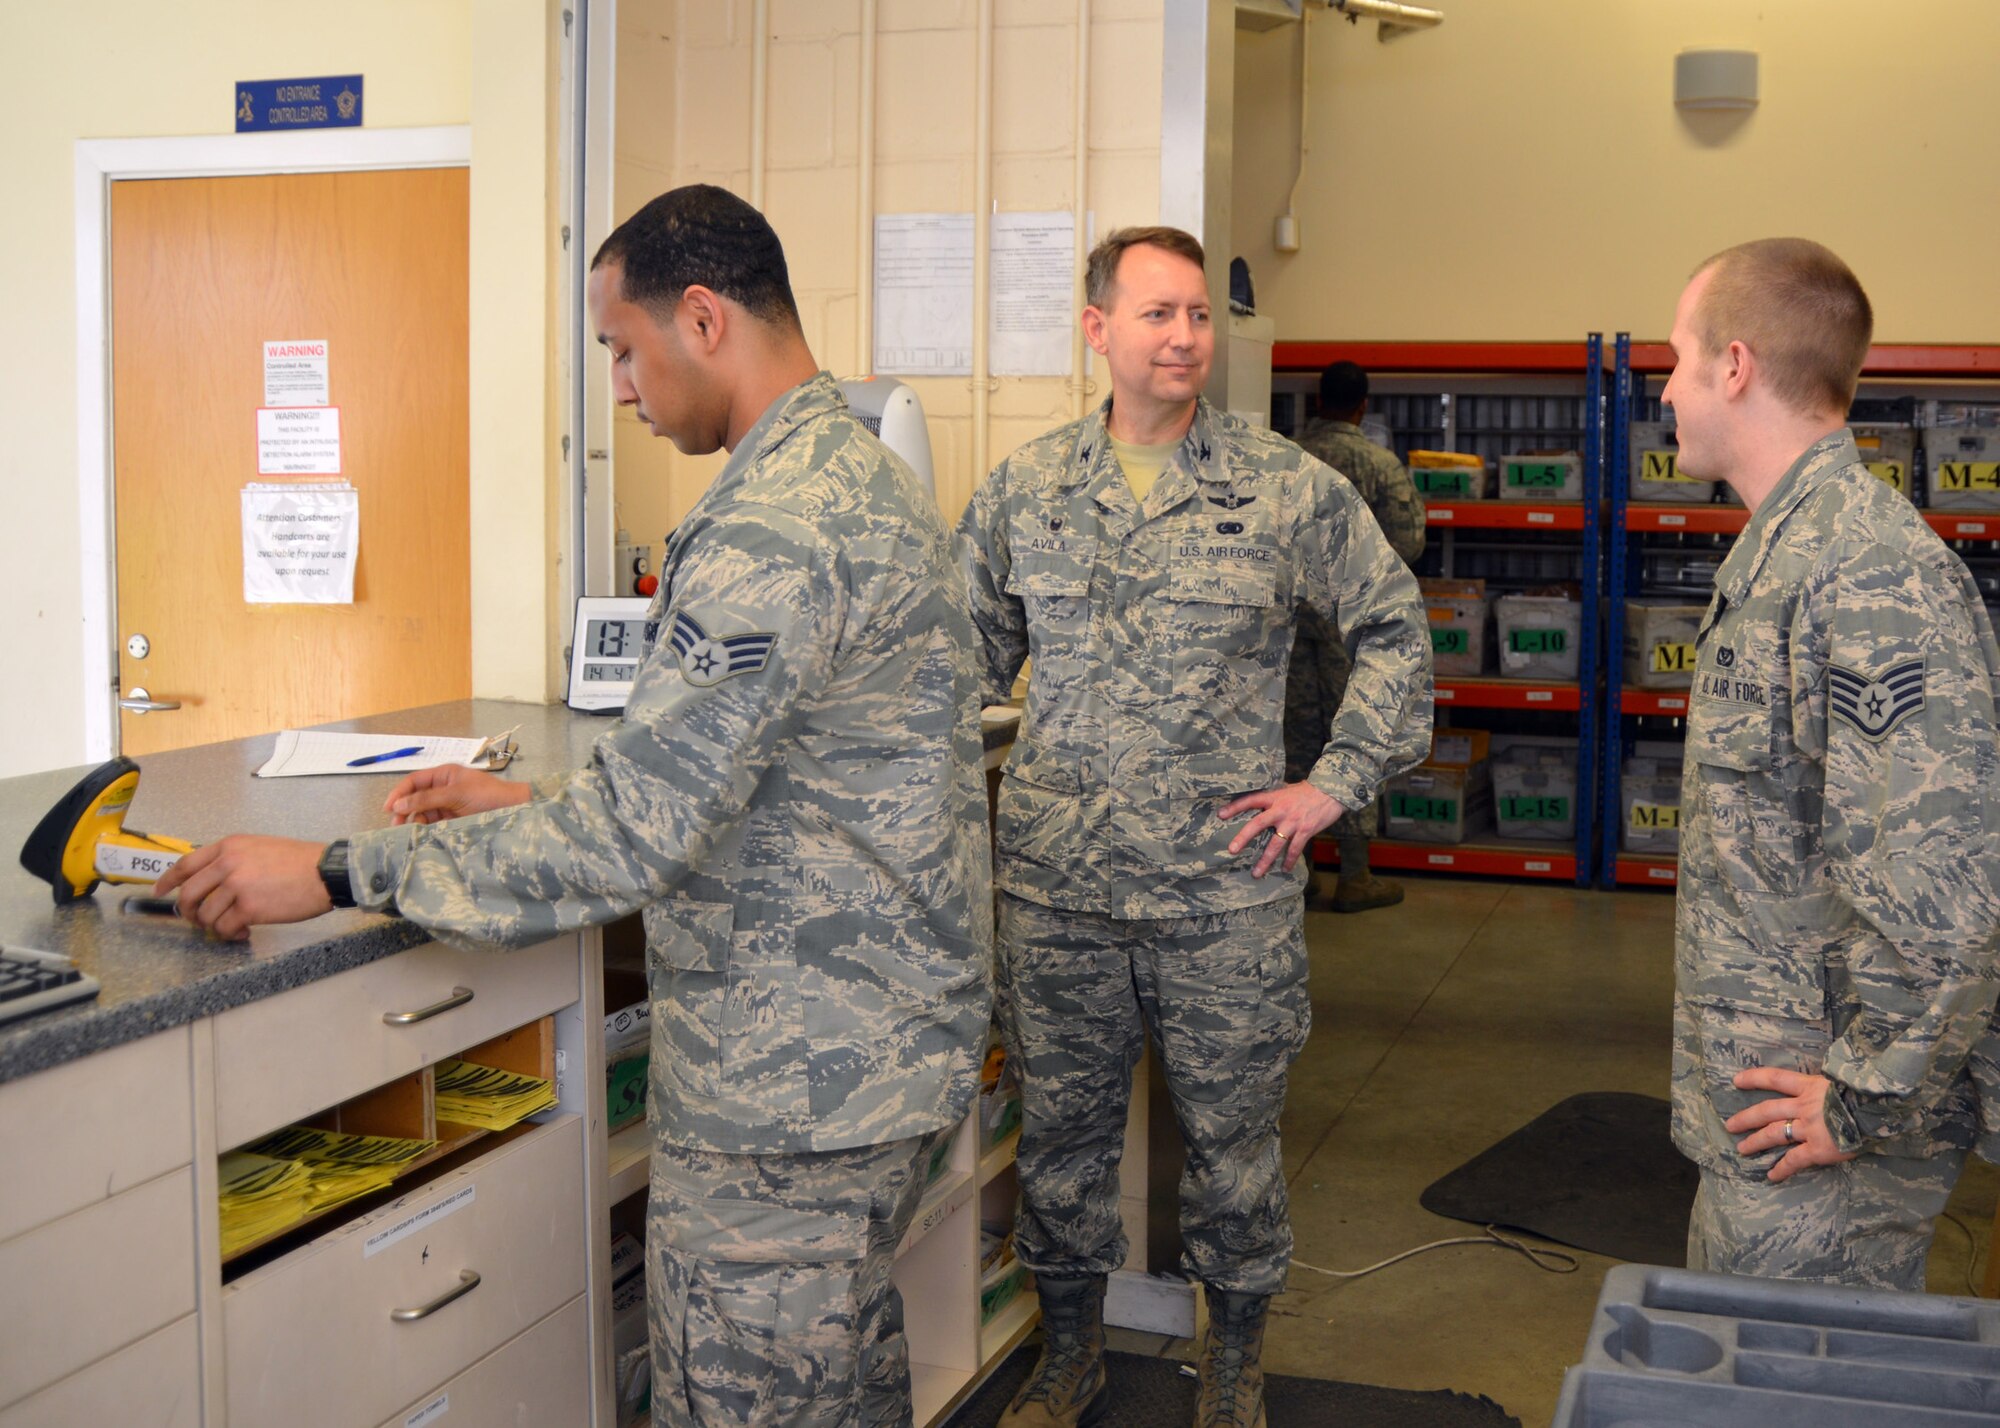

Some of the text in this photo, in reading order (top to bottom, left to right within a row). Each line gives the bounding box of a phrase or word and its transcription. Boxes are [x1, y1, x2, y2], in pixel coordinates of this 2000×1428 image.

[276, 84, 320, 102] NO ENTRANCE
[269, 105, 328, 124] CONTROLLED AREA
[267, 344, 325, 358] WARNING
[266, 361, 312, 370] Controlled Area
[1422, 473, 1461, 492] L-4
[1516, 465, 1557, 486] L-5
[257, 512, 295, 522] Attention
[272, 531, 314, 541] Handcarts
[1031, 538, 1066, 551] AVILA
[257, 548, 347, 560] available for your use
[1179, 545, 1271, 562] U.S. AIR FORCE
[275, 567, 330, 577] upon request
[1511, 631, 1565, 651] L-10
[1657, 645, 1695, 670] M-
[1711, 677, 1729, 699] AIR
[1735, 682, 1766, 705] FORCE
[1400, 799, 1449, 820] L-14
[1509, 799, 1561, 819] L-15
[131, 857, 162, 873] PSC
